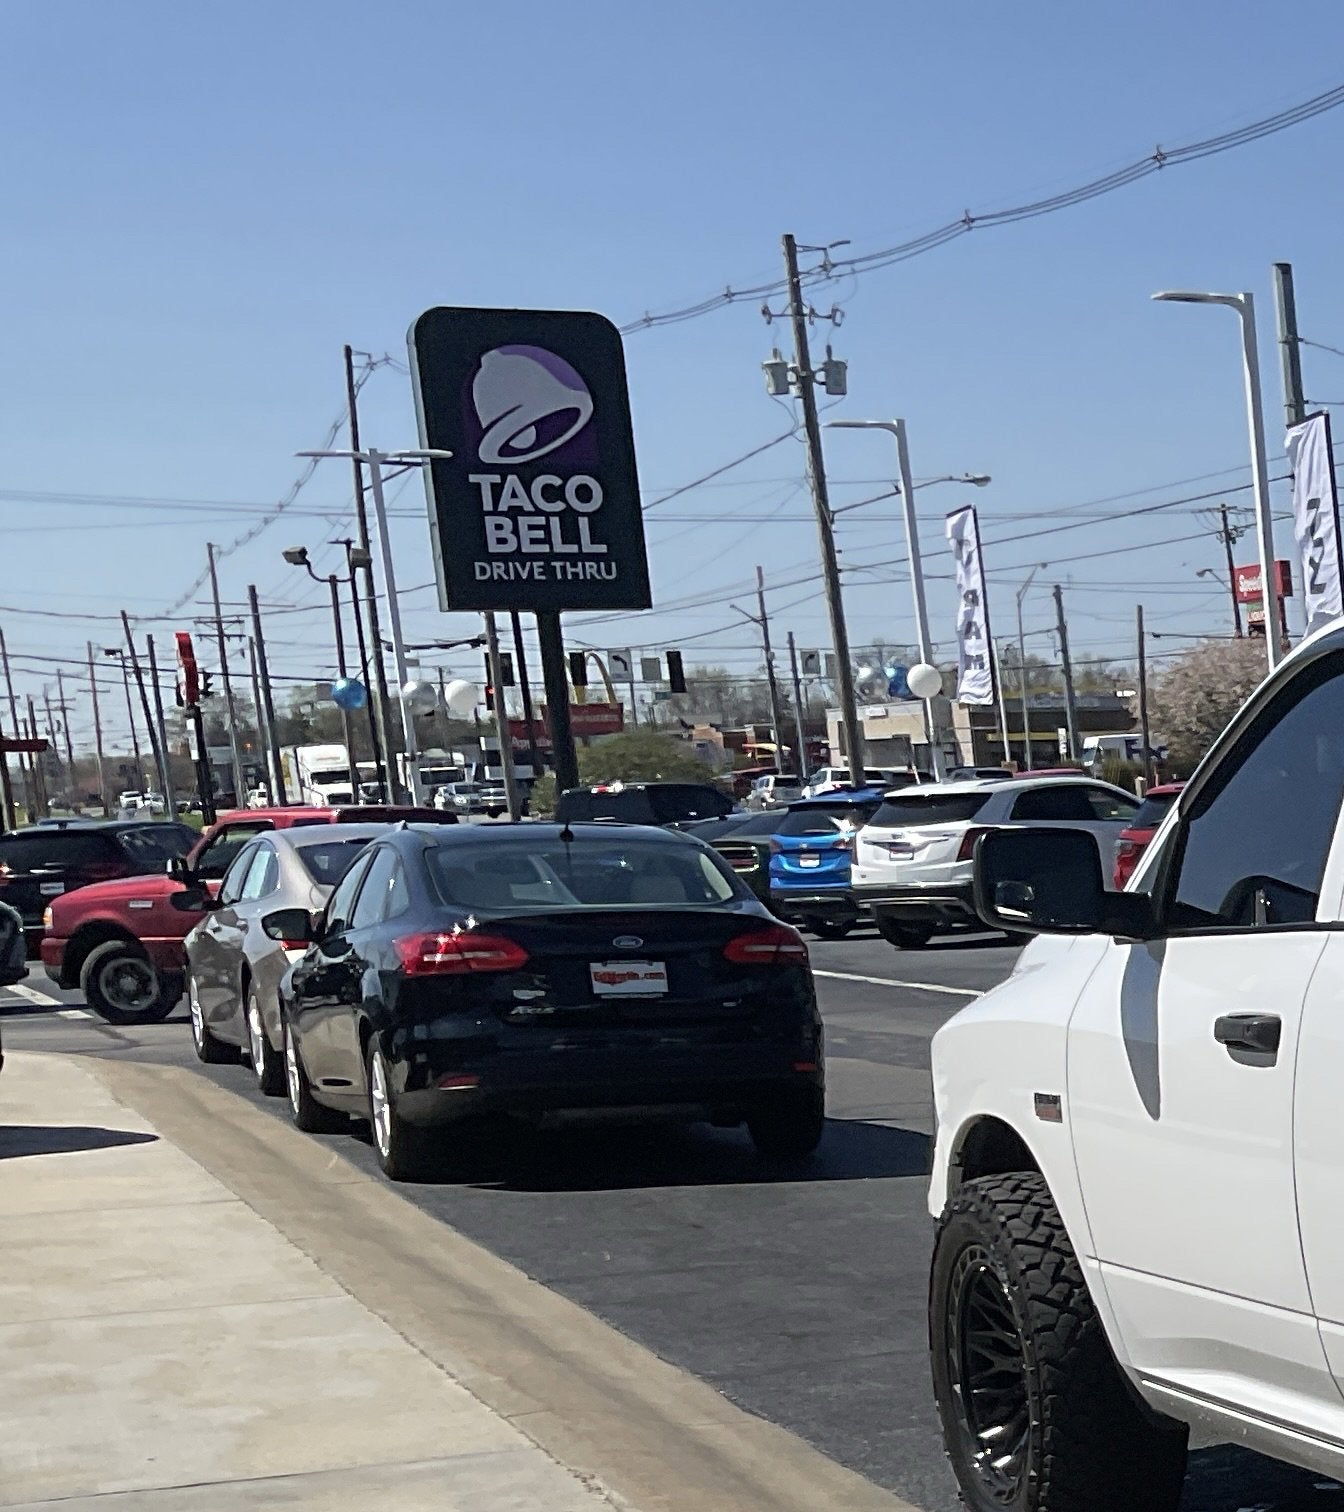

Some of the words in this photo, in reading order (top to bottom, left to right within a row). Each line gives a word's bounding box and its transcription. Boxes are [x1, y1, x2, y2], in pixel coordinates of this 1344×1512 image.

[468, 474, 604, 513] TACO
[484, 515, 608, 553] BELL
[474, 561, 547, 580] DRIVE
[551, 561, 618, 580] THRU
